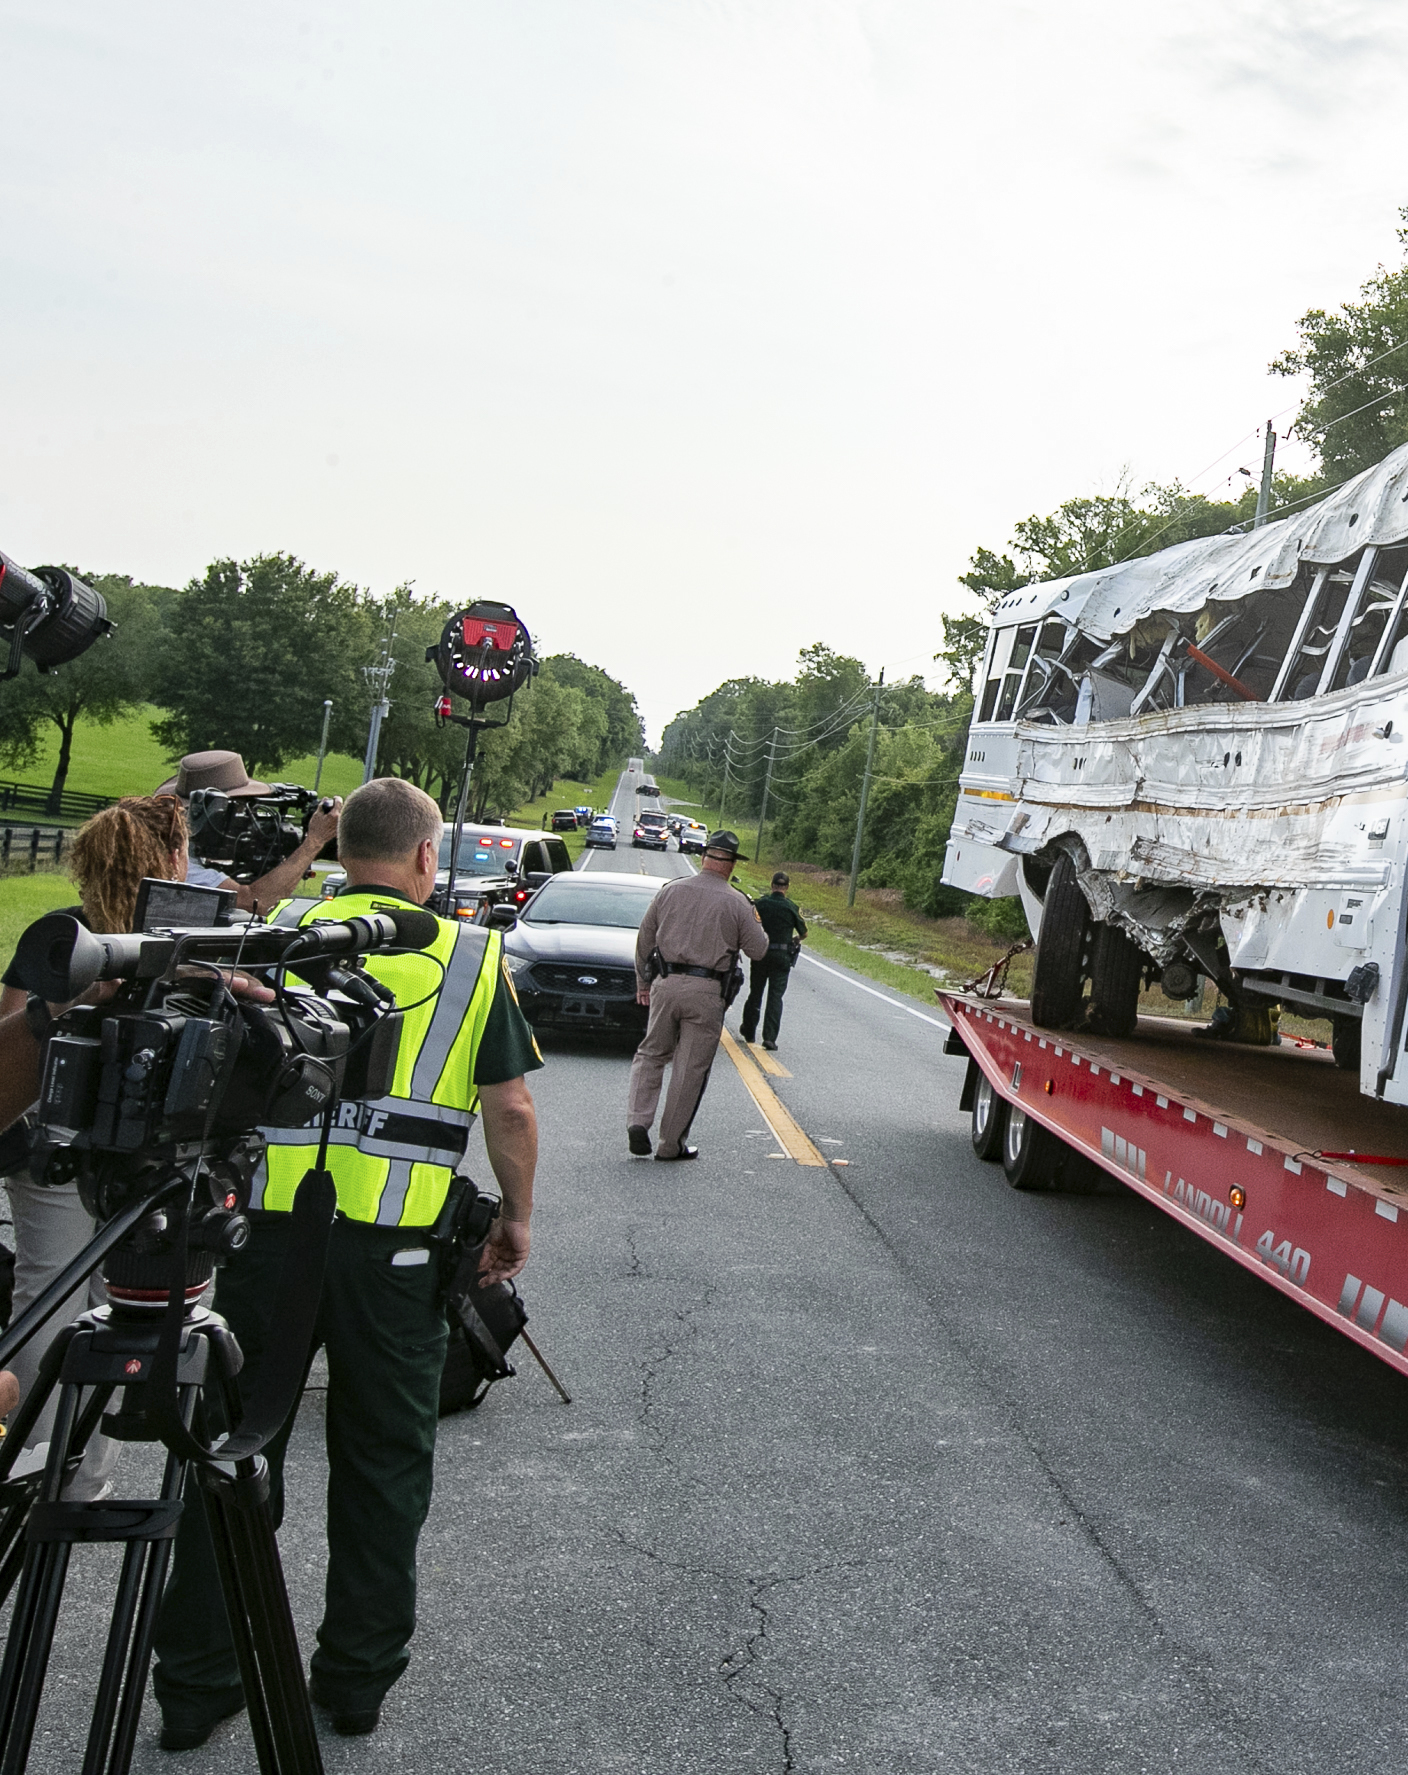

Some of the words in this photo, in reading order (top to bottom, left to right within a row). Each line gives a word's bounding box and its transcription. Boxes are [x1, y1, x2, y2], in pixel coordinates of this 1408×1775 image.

[306, 1085, 326, 1103] SONY
[1163, 1170, 1244, 1249] LANDOLL
[1255, 1230, 1311, 1287] 440
